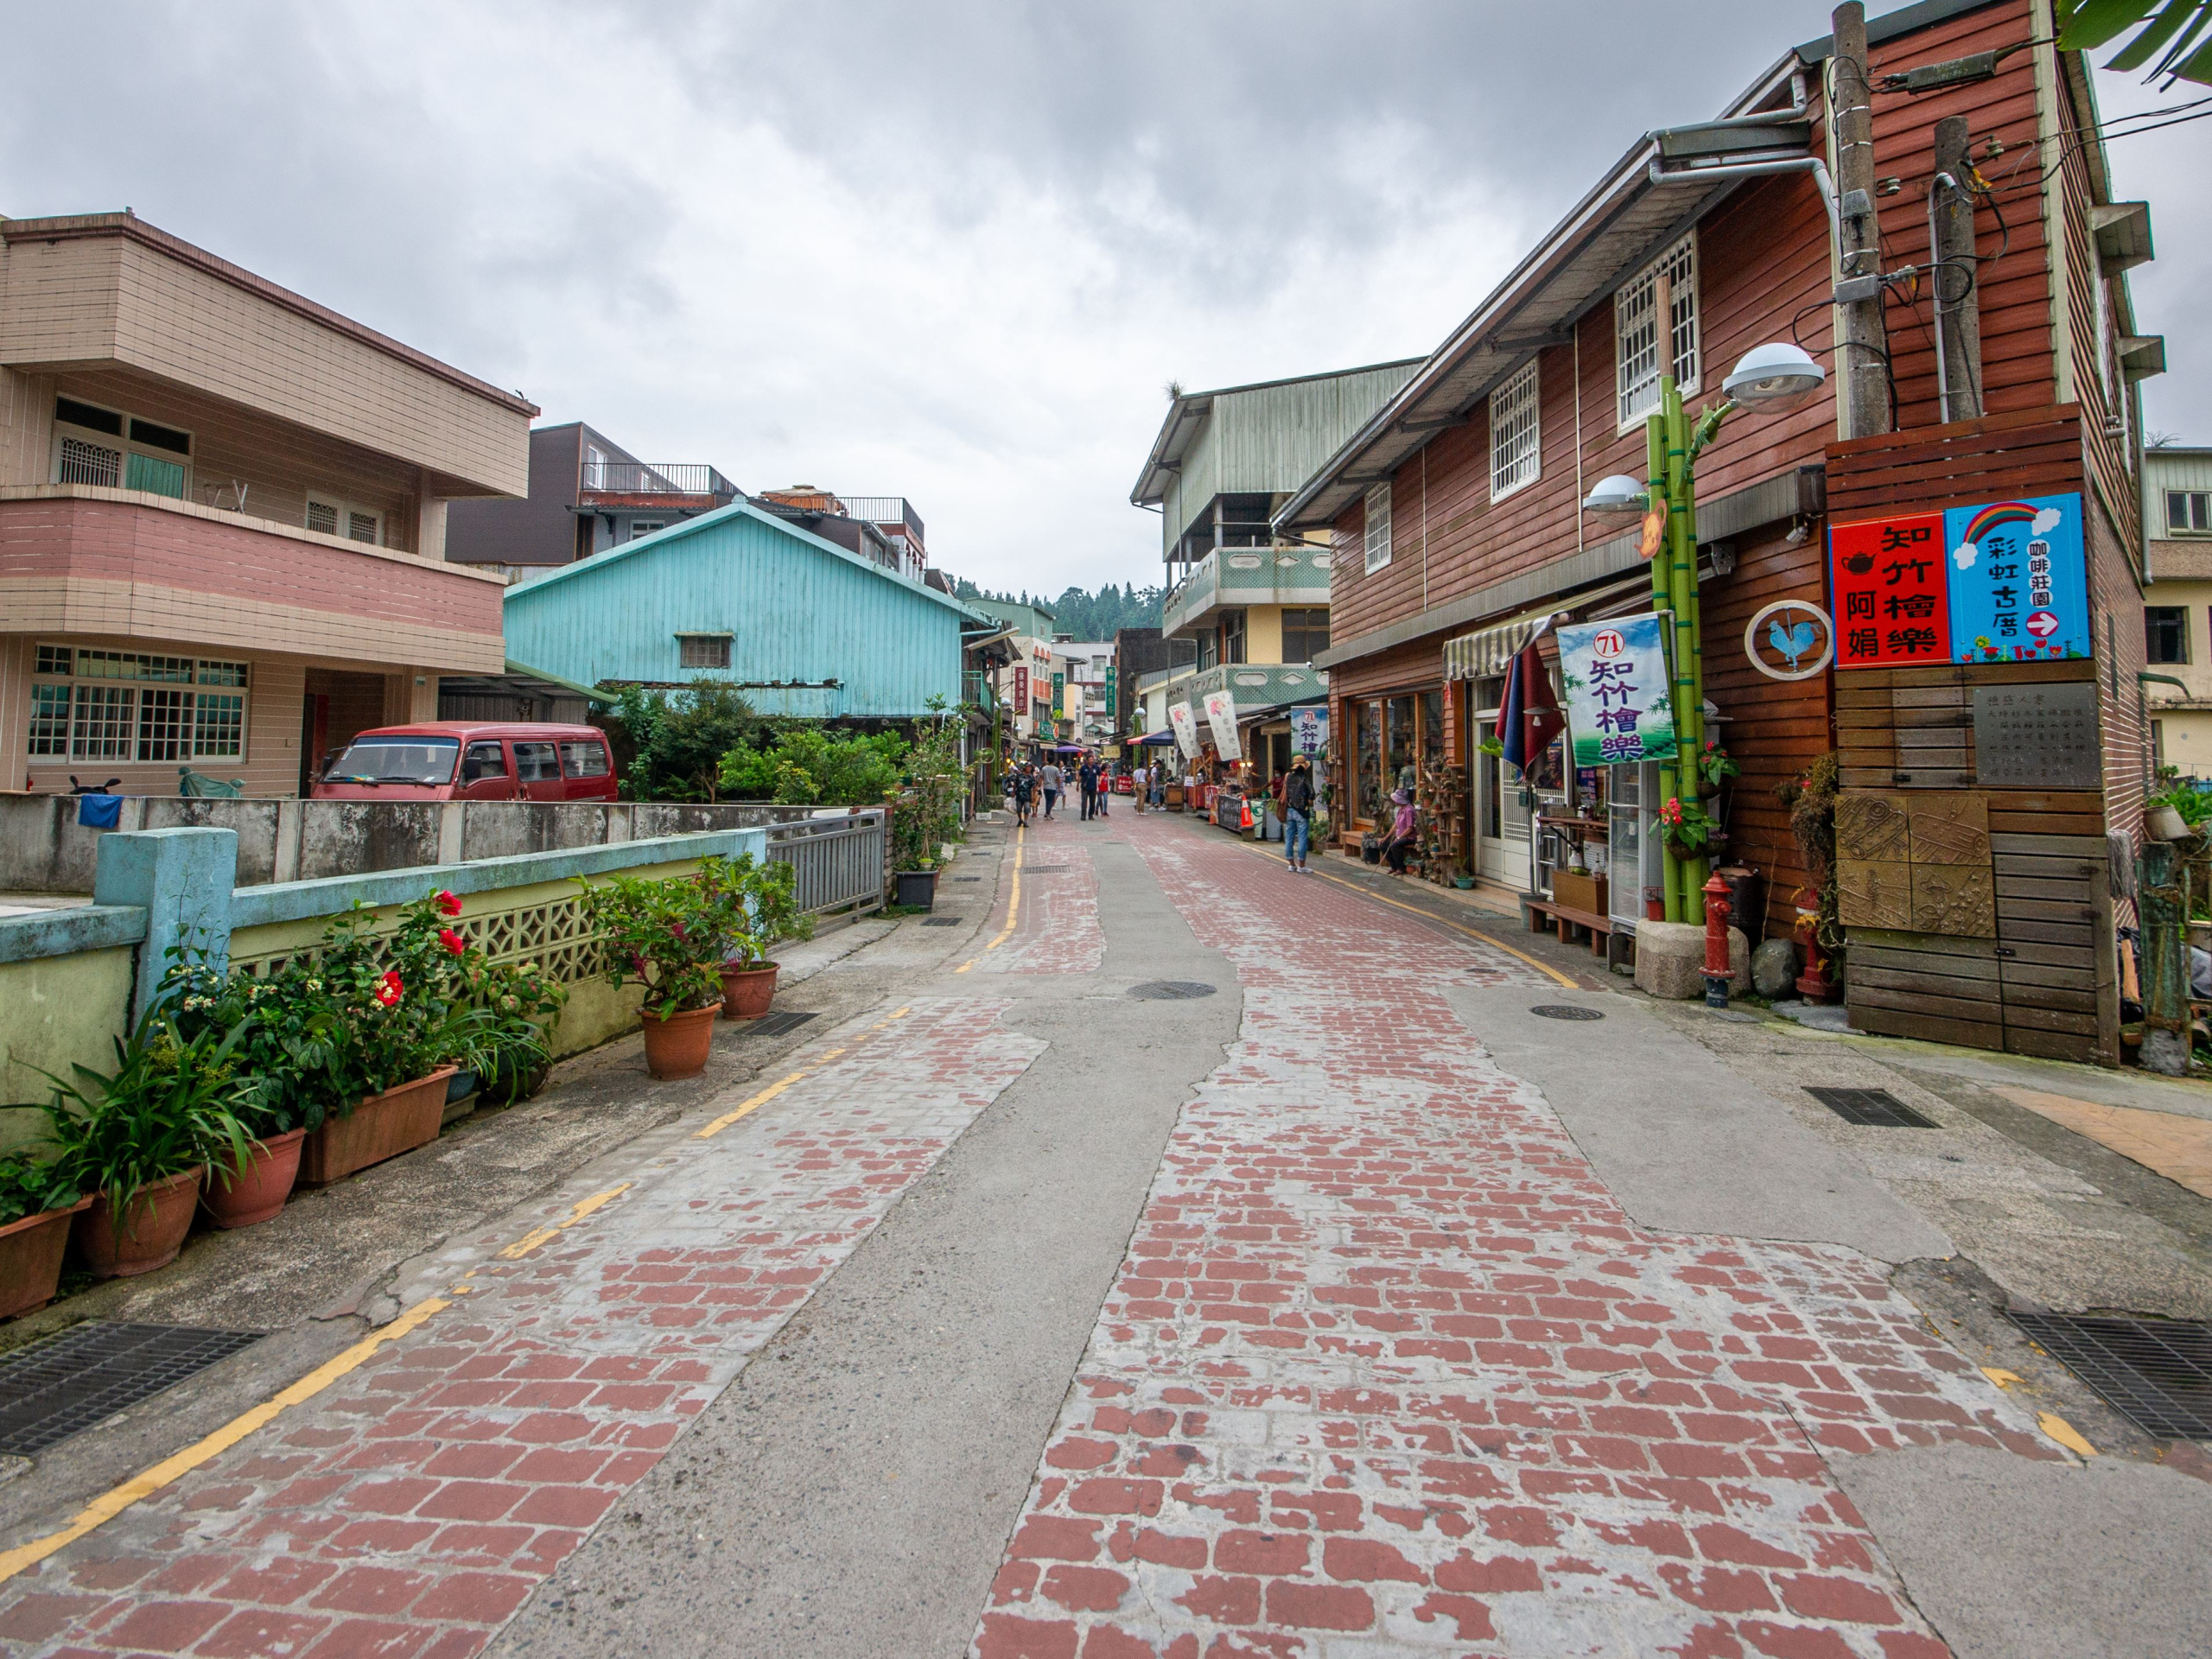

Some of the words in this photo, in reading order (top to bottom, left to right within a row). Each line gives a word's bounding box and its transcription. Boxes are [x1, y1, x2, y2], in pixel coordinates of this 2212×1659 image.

[1881, 525, 1938, 655] 知竹檜樂
[1986, 537, 2019, 638] 彩虹古厝
[2028, 541, 2050, 607] 咖啡莊園
[1597, 636, 1620, 655] 71
[1847, 590, 1879, 658] 阿娟
[1305, 712, 1315, 721] 71
[1589, 660, 1645, 761] 知竹檜樂
